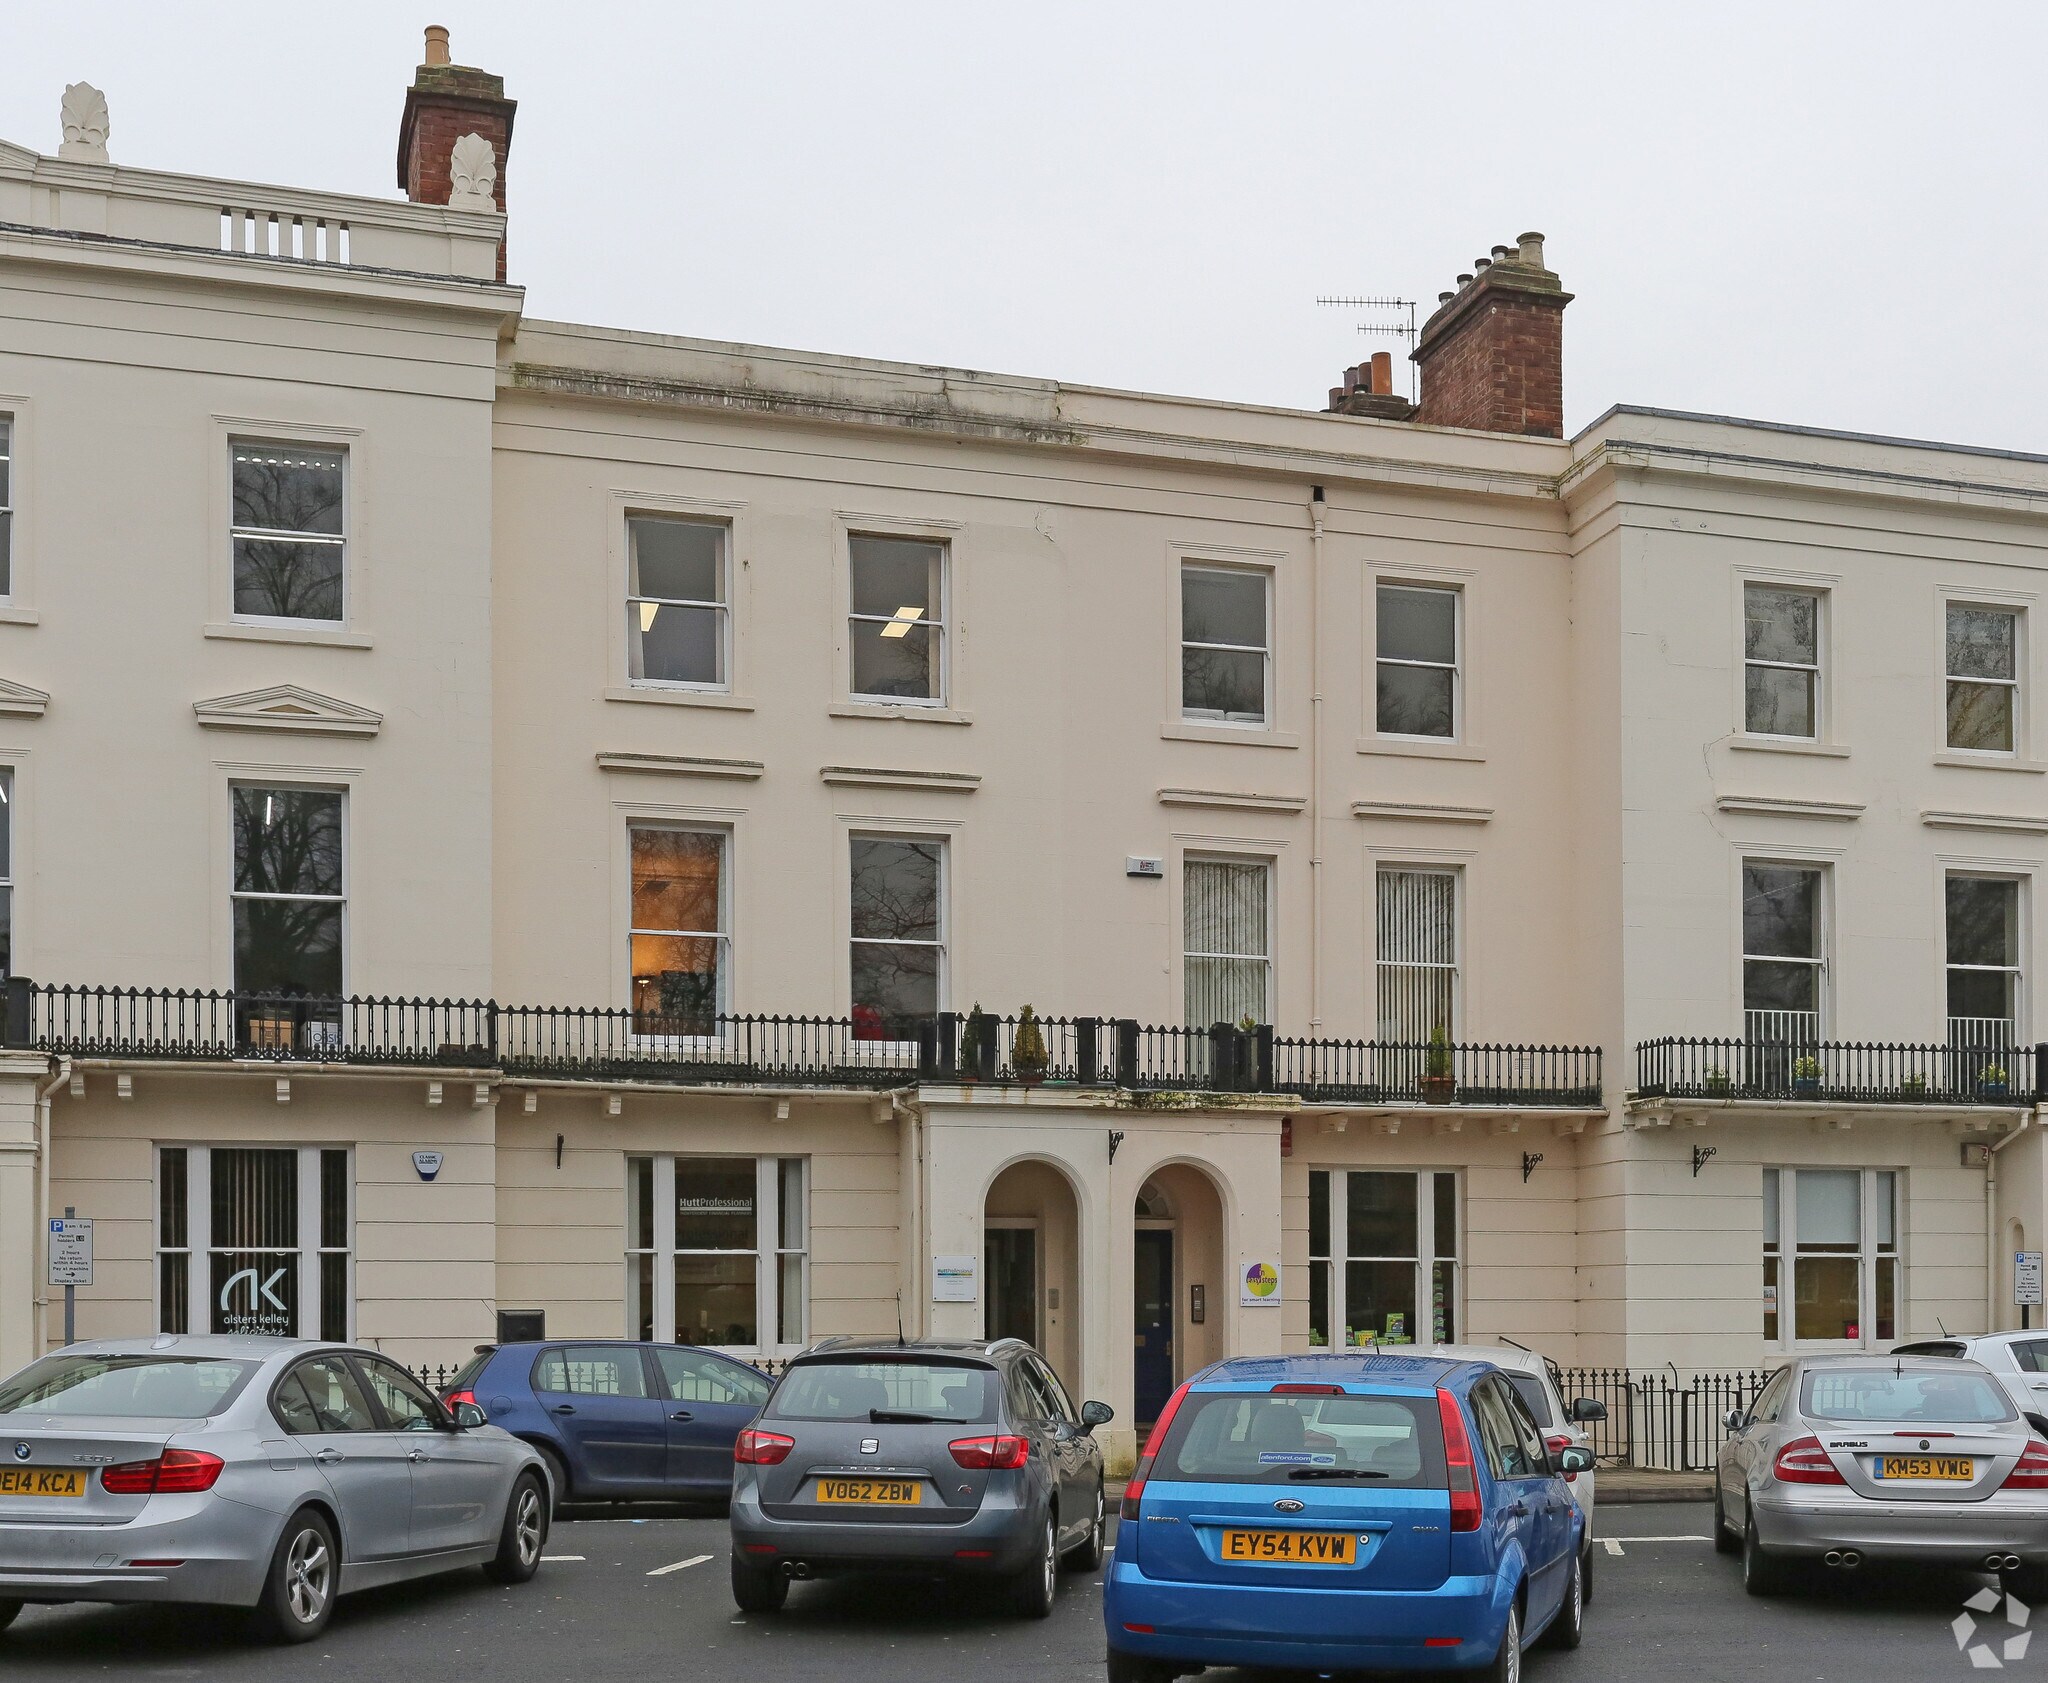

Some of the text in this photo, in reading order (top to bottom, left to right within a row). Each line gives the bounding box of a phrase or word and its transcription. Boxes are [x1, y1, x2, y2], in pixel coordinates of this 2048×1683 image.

[680, 1196, 752, 1207] HuttProfessional
[224, 1314, 289, 1326] alsters kelley
[227, 1326, 286, 1336] solicitors
[1886, 1459, 1970, 1476] KM53 VWG
[0, 1472, 76, 1492] E14 KCA
[877, 1484, 913, 1501] ZBW
[1231, 1533, 1346, 1558] EY54 KVW
